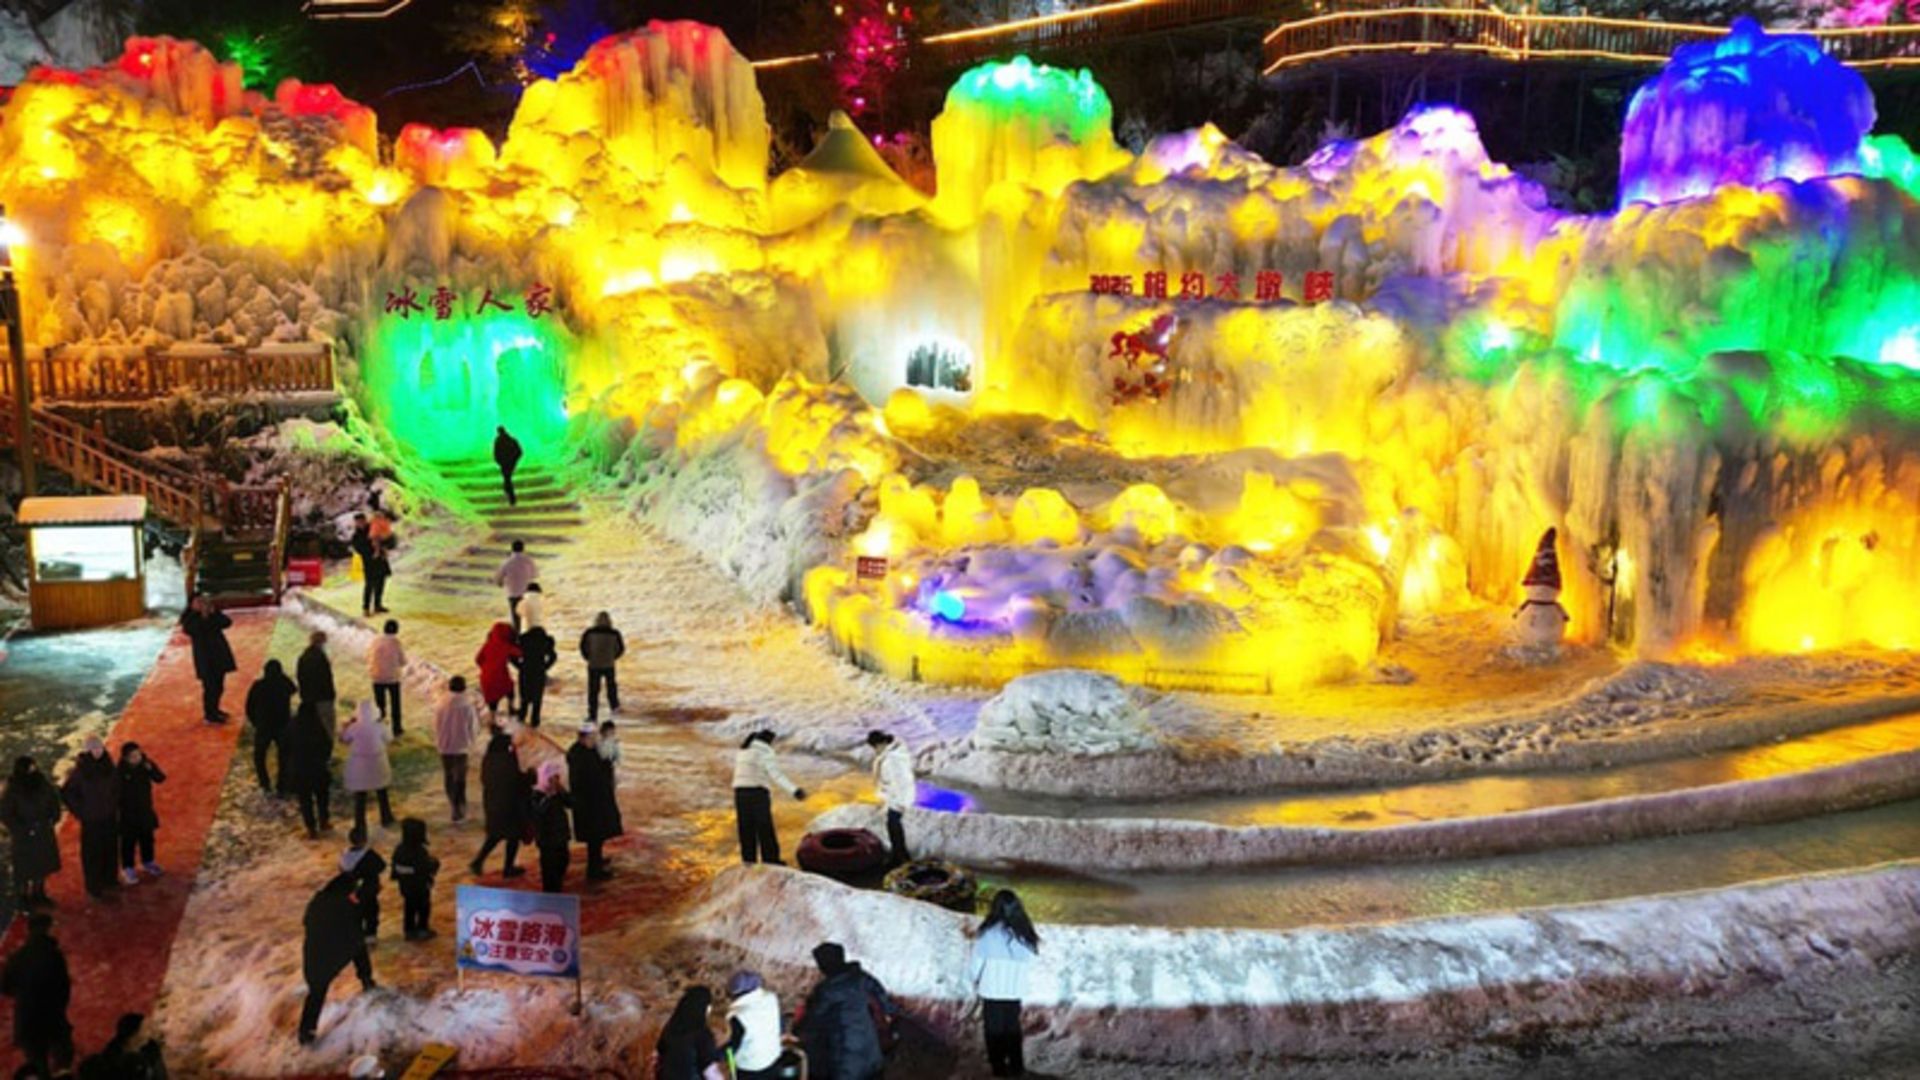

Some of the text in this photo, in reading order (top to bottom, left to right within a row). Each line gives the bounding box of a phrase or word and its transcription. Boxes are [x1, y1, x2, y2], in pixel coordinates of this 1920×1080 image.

[384, 281, 554, 320] 冰雪人家
[471, 916, 568, 947] 冰雪路滑
[488, 943, 550, 963] 注意安全
